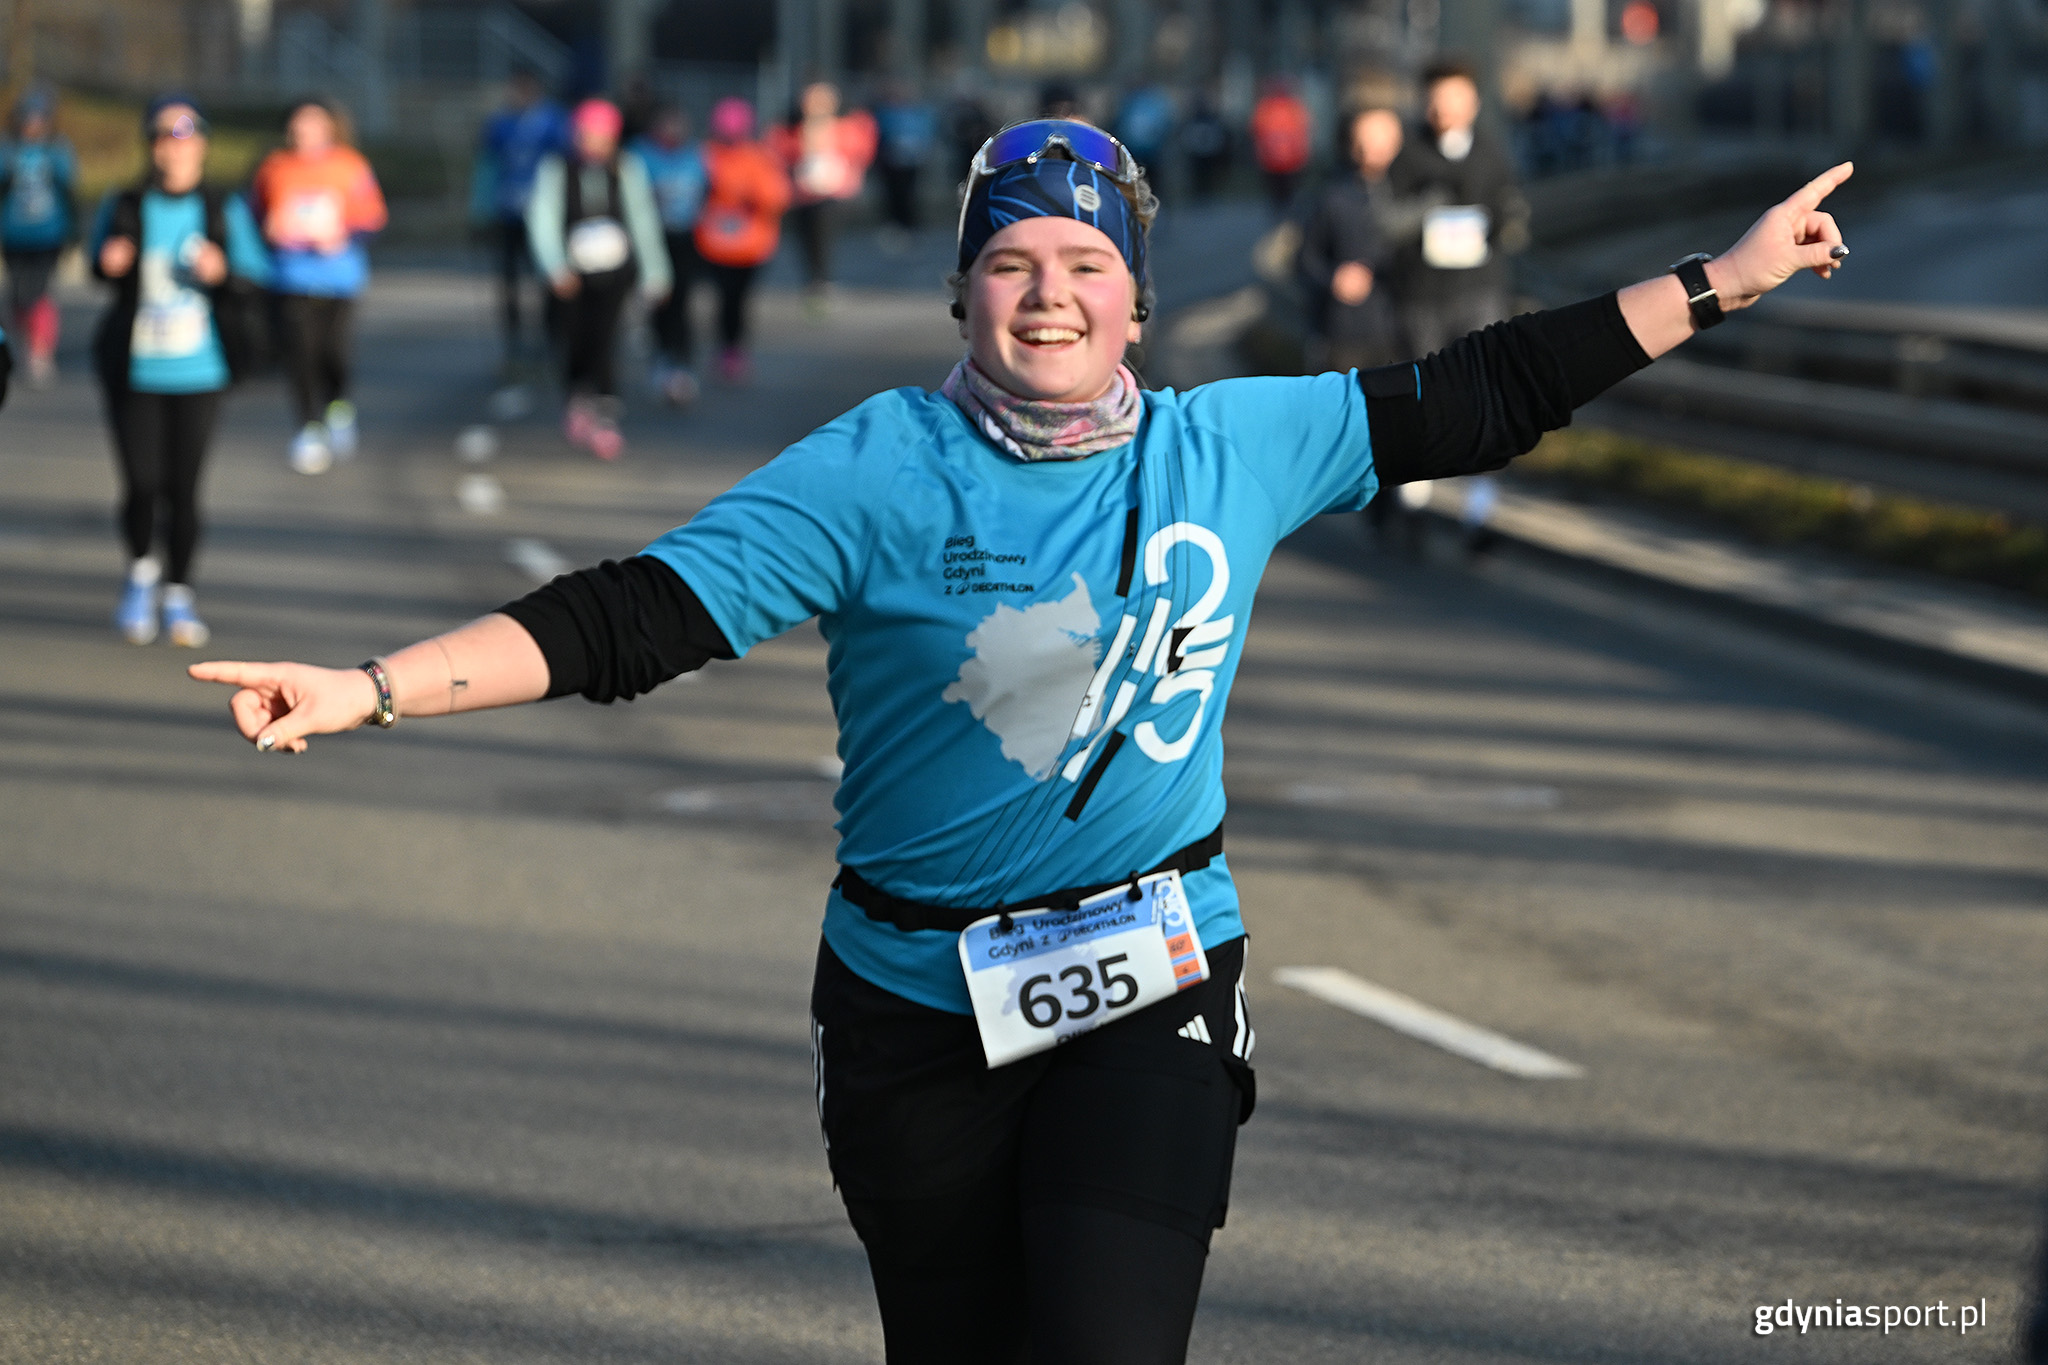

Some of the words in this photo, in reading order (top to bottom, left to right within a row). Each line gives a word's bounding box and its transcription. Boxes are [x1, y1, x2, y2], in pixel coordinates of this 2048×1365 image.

[945, 534, 975, 549] Bieg
[943, 548, 1026, 565] Urodzinowy
[943, 563, 985, 580] Gdyni
[971, 582, 1034, 593] DECATHLON
[989, 923, 1025, 939] Bg
[1032, 901, 1123, 931] Urodzinowy
[988, 937, 1034, 960] Gdyni
[1075, 913, 1136, 935] DECATHLON
[1019, 953, 1139, 1029] 635
